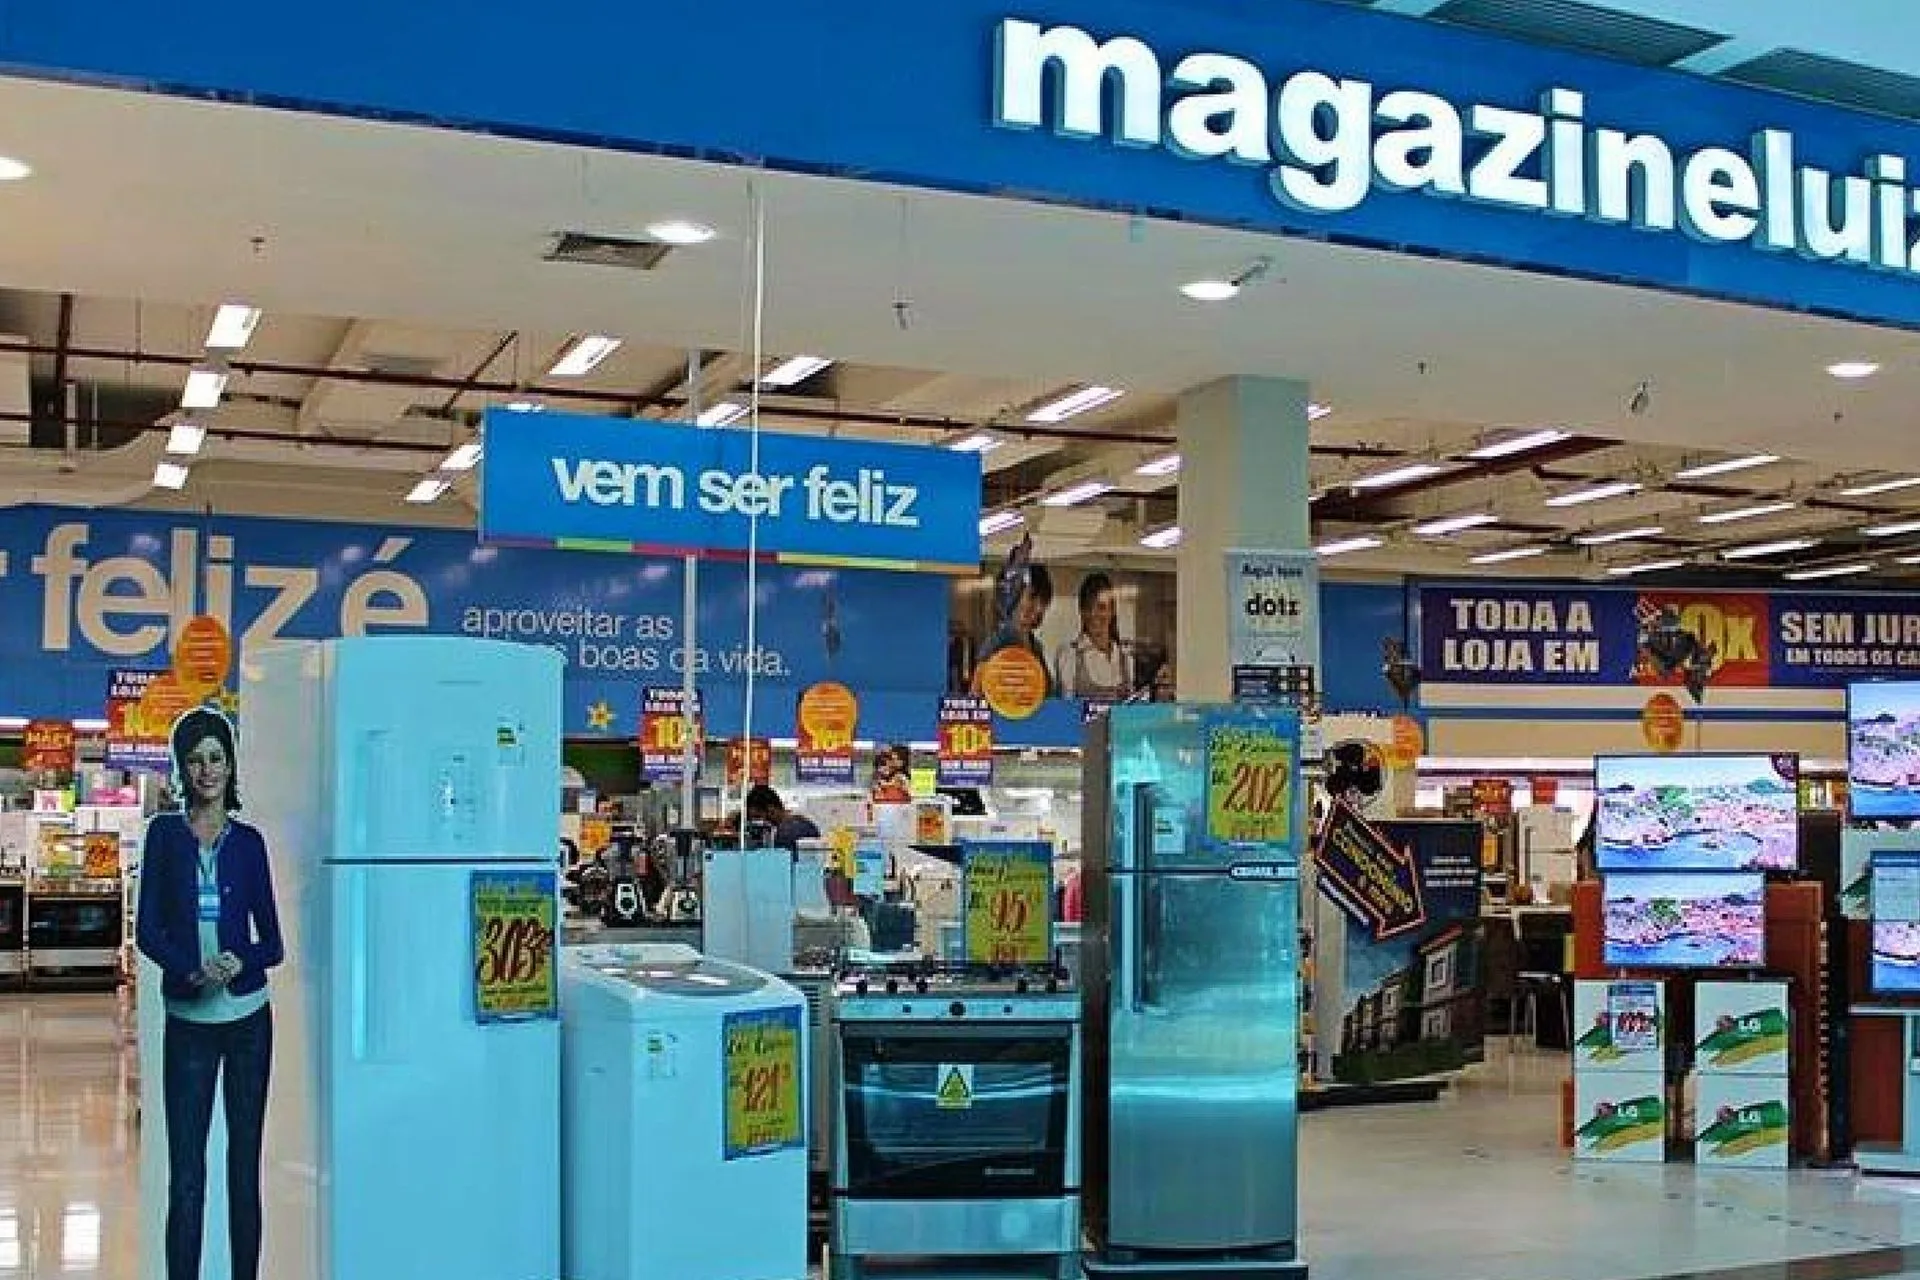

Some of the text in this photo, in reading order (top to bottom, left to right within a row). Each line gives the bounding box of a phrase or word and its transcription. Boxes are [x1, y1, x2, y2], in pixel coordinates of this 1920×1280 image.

[552, 457, 920, 527] vem ser feliz
[31, 523, 429, 656] feliz é
[462, 604, 674, 640] aproveitar as
[1449, 598, 1594, 634] TODA A
[1781, 611, 1855, 644] SEM
[578, 638, 661, 670] boas
[717, 643, 792, 676] vida.
[1443, 638, 1601, 672] LOJA EM
